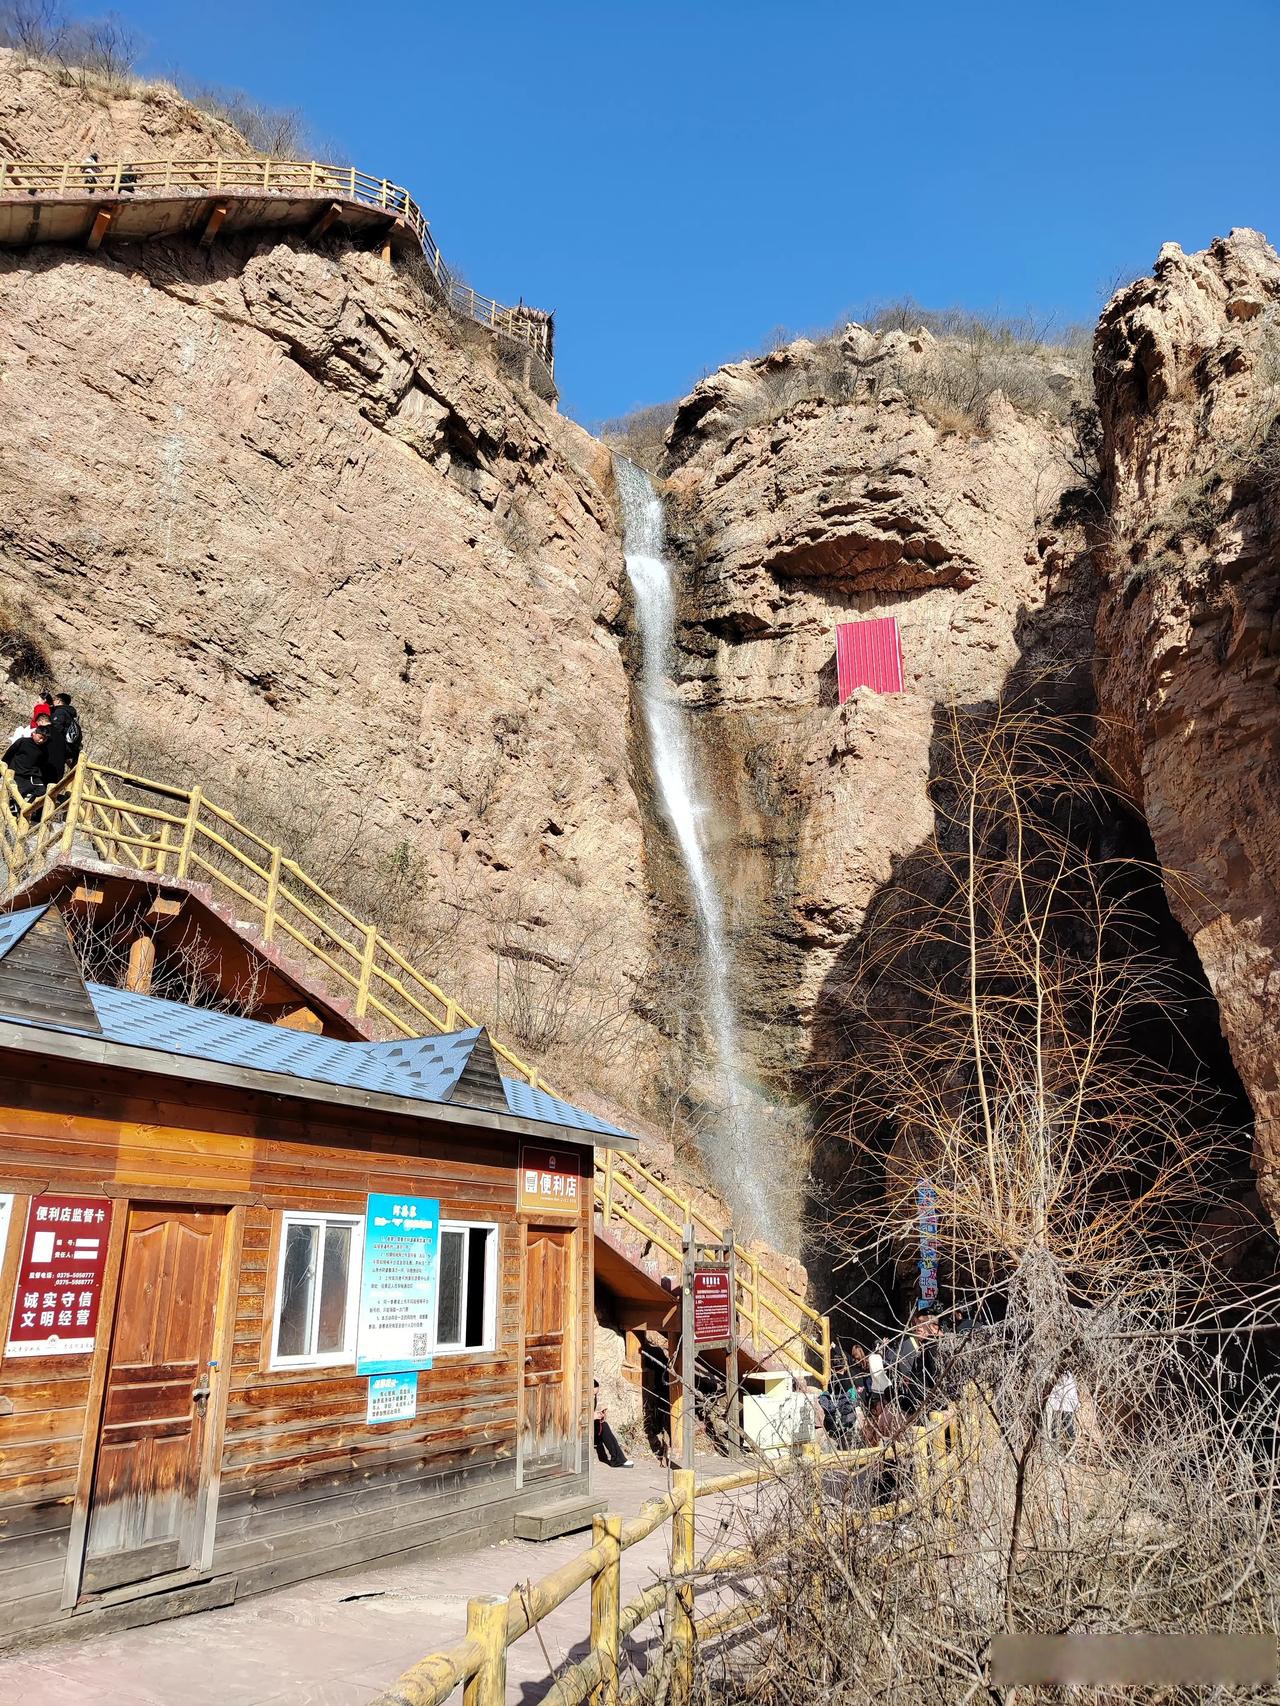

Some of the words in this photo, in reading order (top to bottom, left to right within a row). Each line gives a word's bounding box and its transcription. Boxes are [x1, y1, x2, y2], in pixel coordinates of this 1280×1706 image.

[540, 1173, 576, 1197] 便利店
[36, 1206, 105, 1223] 便利店监督卡
[24, 1292, 93, 1308] 诚实守信
[20, 1310, 90, 1327] 文明经营
